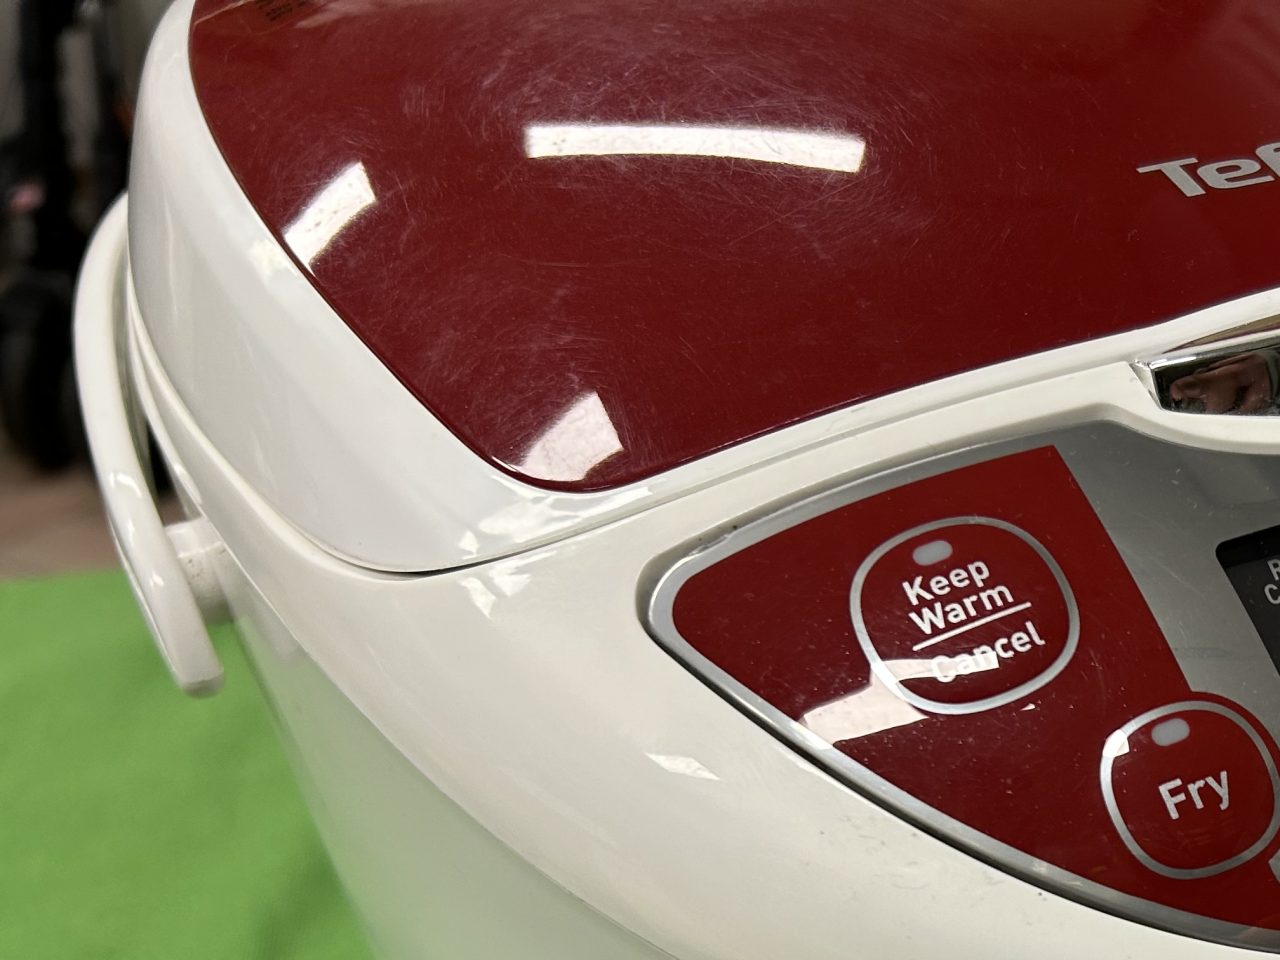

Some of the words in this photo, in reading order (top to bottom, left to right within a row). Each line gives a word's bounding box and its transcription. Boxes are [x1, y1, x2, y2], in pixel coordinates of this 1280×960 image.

[902, 558, 991, 606] Keep
[909, 581, 1014, 635] Warm
[931, 620, 1046, 683] Cancel
[1158, 770, 1229, 820] Fry
